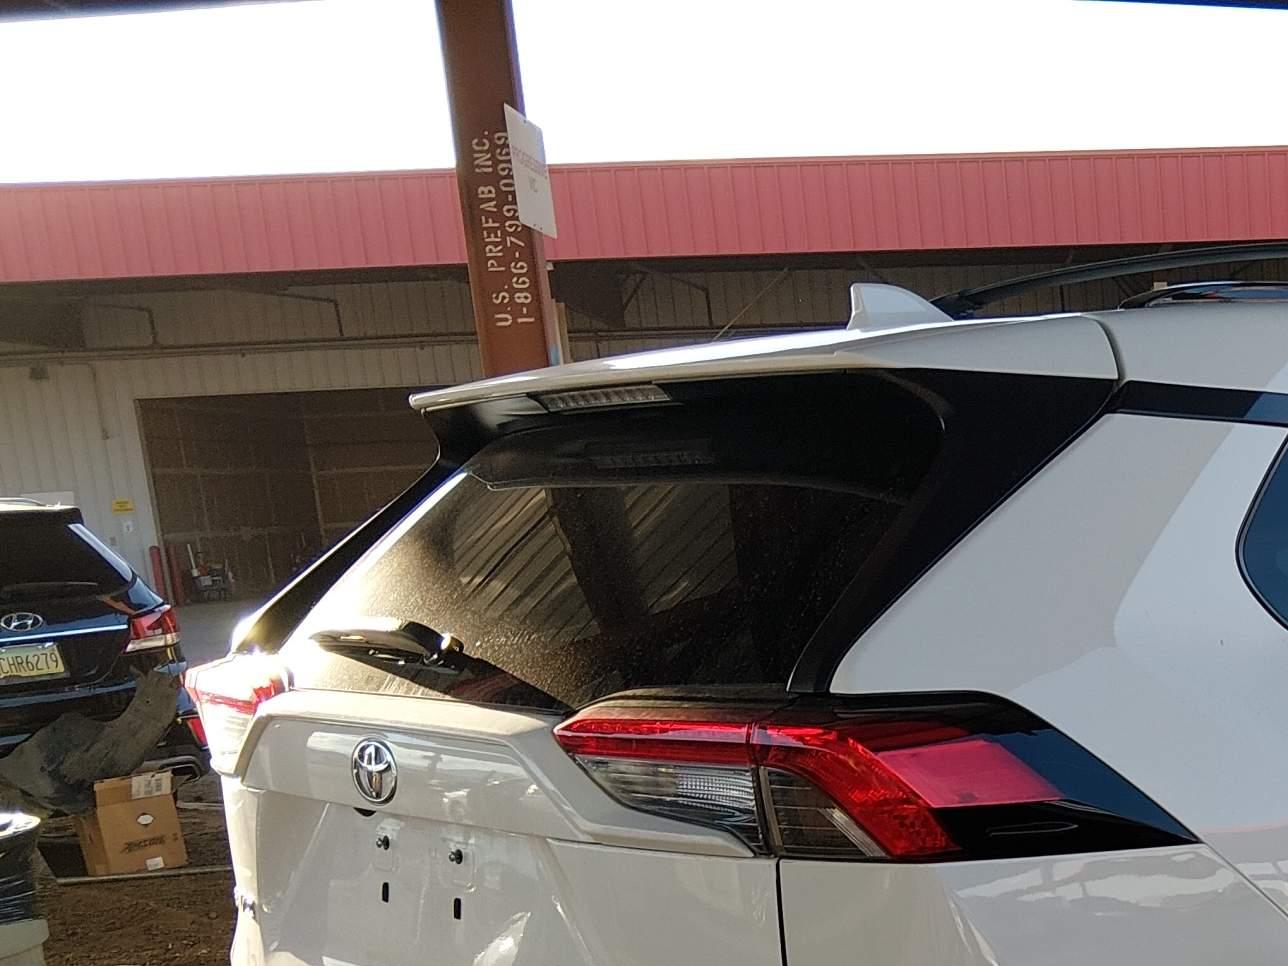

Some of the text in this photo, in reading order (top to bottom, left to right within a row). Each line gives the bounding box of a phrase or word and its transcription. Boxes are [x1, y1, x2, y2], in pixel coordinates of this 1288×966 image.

[471, 130, 513, 327] U.S. PREFAB INC.
[494, 132, 535, 324] 1-866-799-0969
[0, 652, 59, 675] CHR6279
